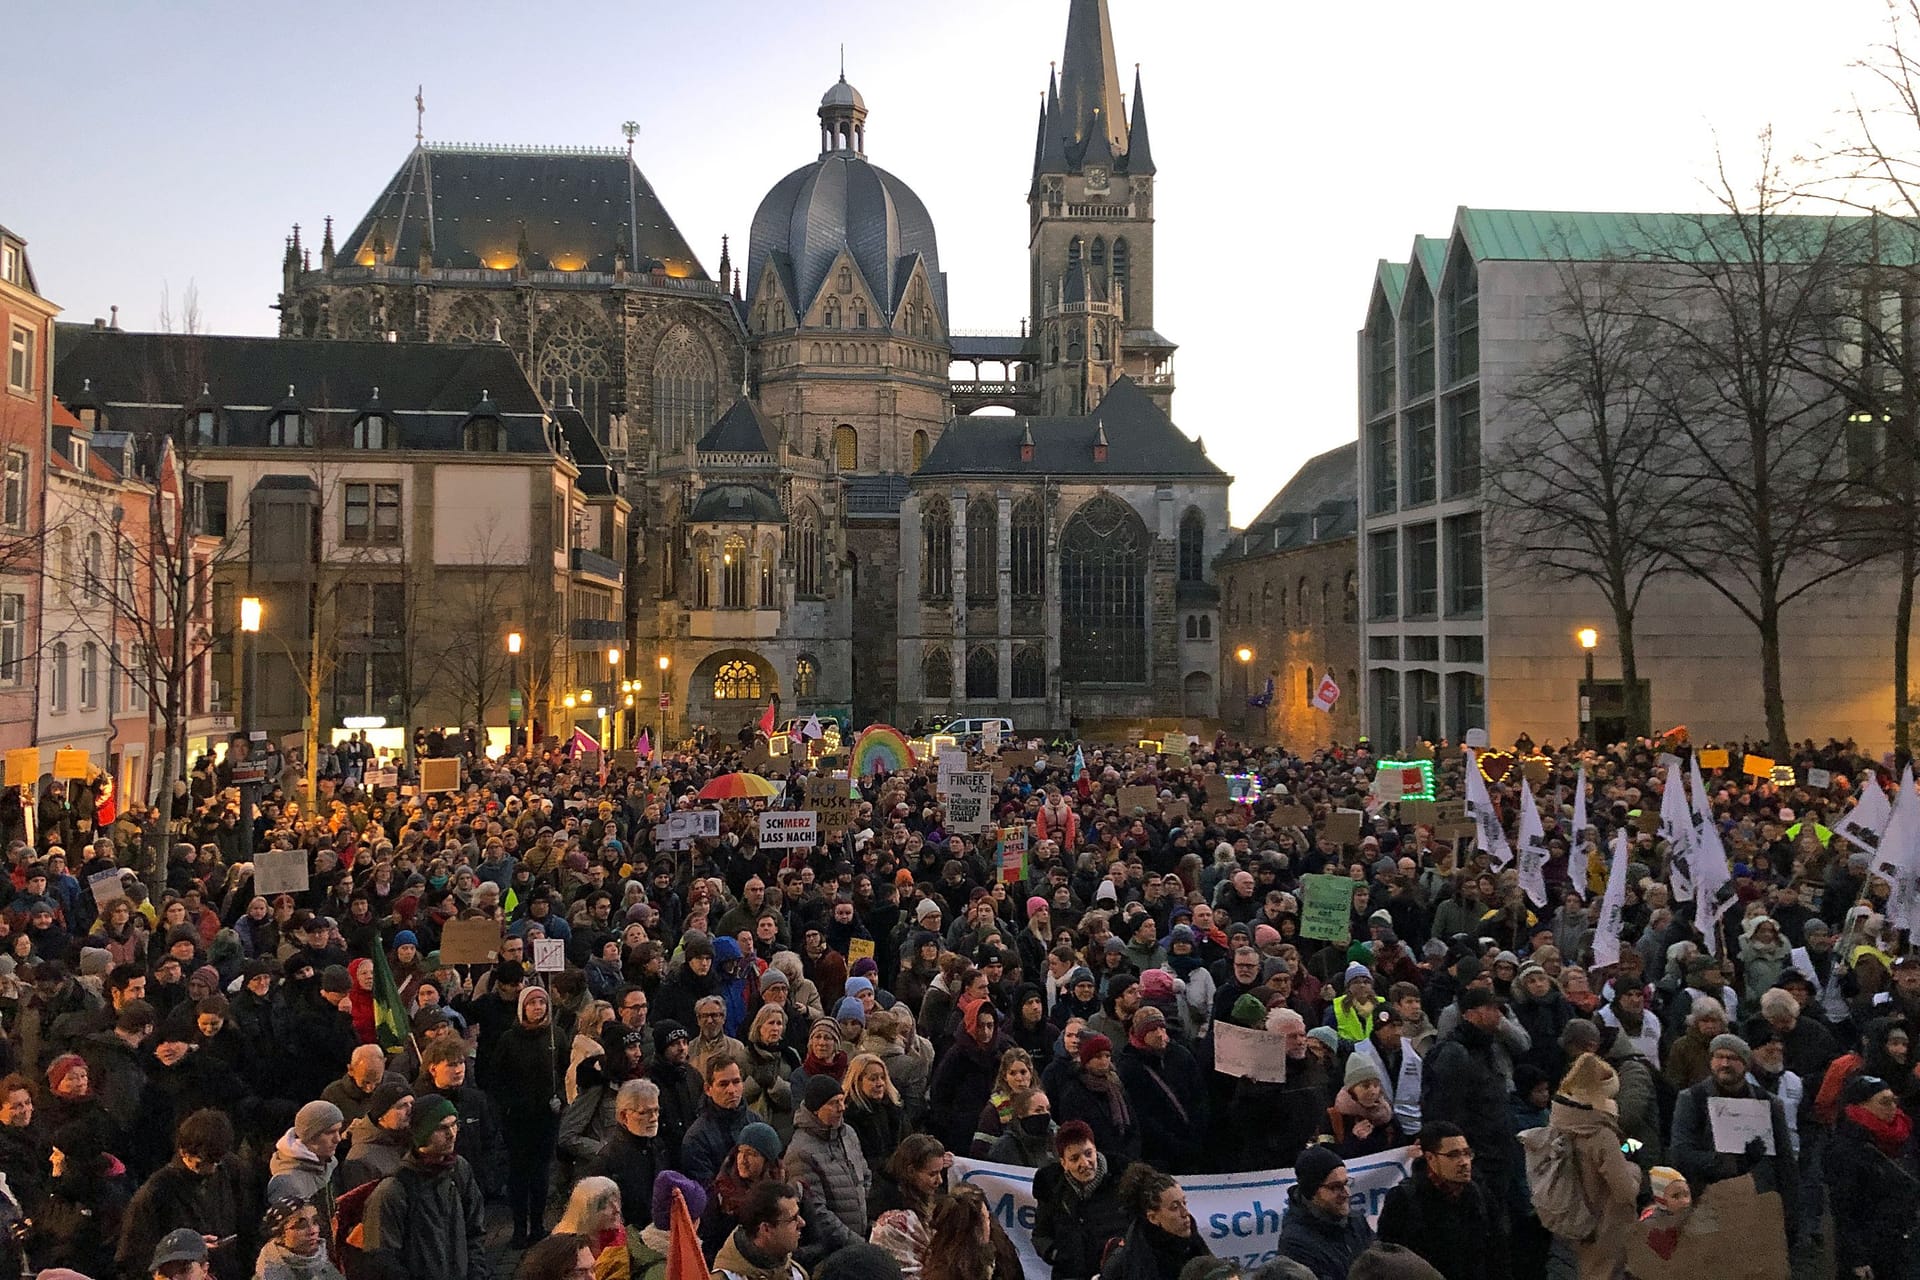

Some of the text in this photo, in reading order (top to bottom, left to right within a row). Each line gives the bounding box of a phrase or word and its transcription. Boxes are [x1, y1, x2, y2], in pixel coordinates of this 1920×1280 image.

[950, 775, 984, 786] FINGER
[811, 795, 846, 808] MUSK
[766, 818, 811, 829] SCHMERZ
[816, 811, 848, 826] OTZEN
[761, 831, 815, 843] LASS NACH!
